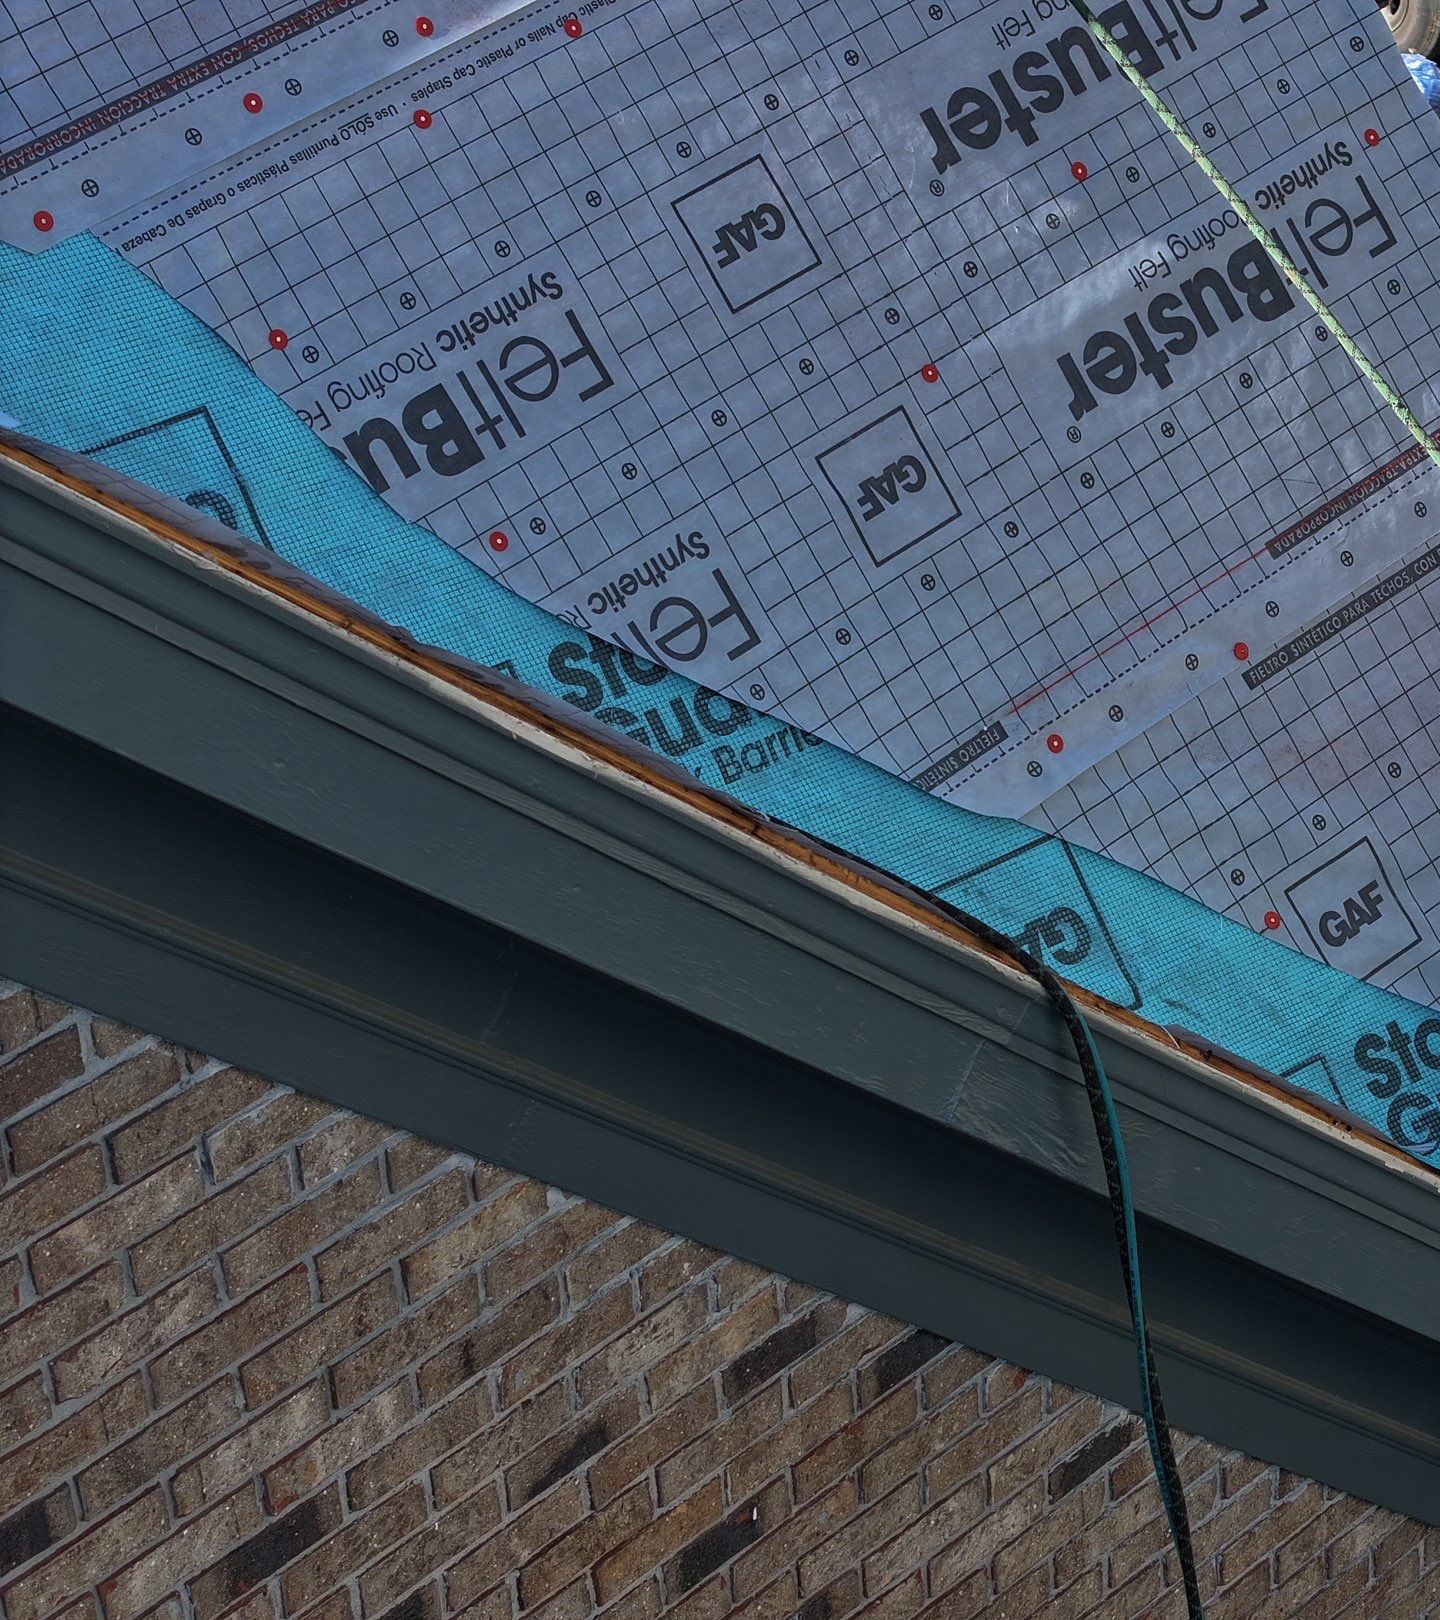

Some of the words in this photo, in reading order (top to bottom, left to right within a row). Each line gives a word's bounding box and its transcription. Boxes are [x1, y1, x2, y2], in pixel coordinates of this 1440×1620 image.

[515, 37, 526, 50] or
[527, 22, 556, 42] Nails
[990, 9, 1037, 50] Felt
[453, 64, 476, 82] Cap
[477, 44, 515, 69] Plastic
[410, 76, 452, 102] Staples
[338, 114, 375, 141] SÓLO
[375, 104, 399, 120] Use
[289, 134, 340, 165] Puntillas
[227, 187, 236, 198] o
[236, 163, 290, 193] Plásticas
[1254, 141, 1353, 211] Synthetic
[167, 214, 185, 229] De
[184, 191, 227, 220] Grapas
[121, 223, 167, 253] Cabeza
[712, 203, 786, 269] GAF
[1166, 209, 1248, 262] oofing
[1127, 249, 1172, 292] Felt
[435, 271, 563, 351] Synthetic
[326, 342, 437, 413] Roofing
[857, 455, 927, 522] GAF
[587, 531, 711, 615] Synthetic
[1250, 651, 1289, 684] FIELTRO
[1290, 615, 1342, 656] SINTÉTICO
[1343, 600, 1371, 623] PARA
[1370, 571, 1414, 604] TECHOS,
[1414, 554, 1437, 575] CON
[960, 728, 1001, 762] FIELTRO
[915, 756, 959, 791] SINTÉTIC
[1319, 880, 1384, 947] GAF
[1009, 907, 1092, 966] GA
